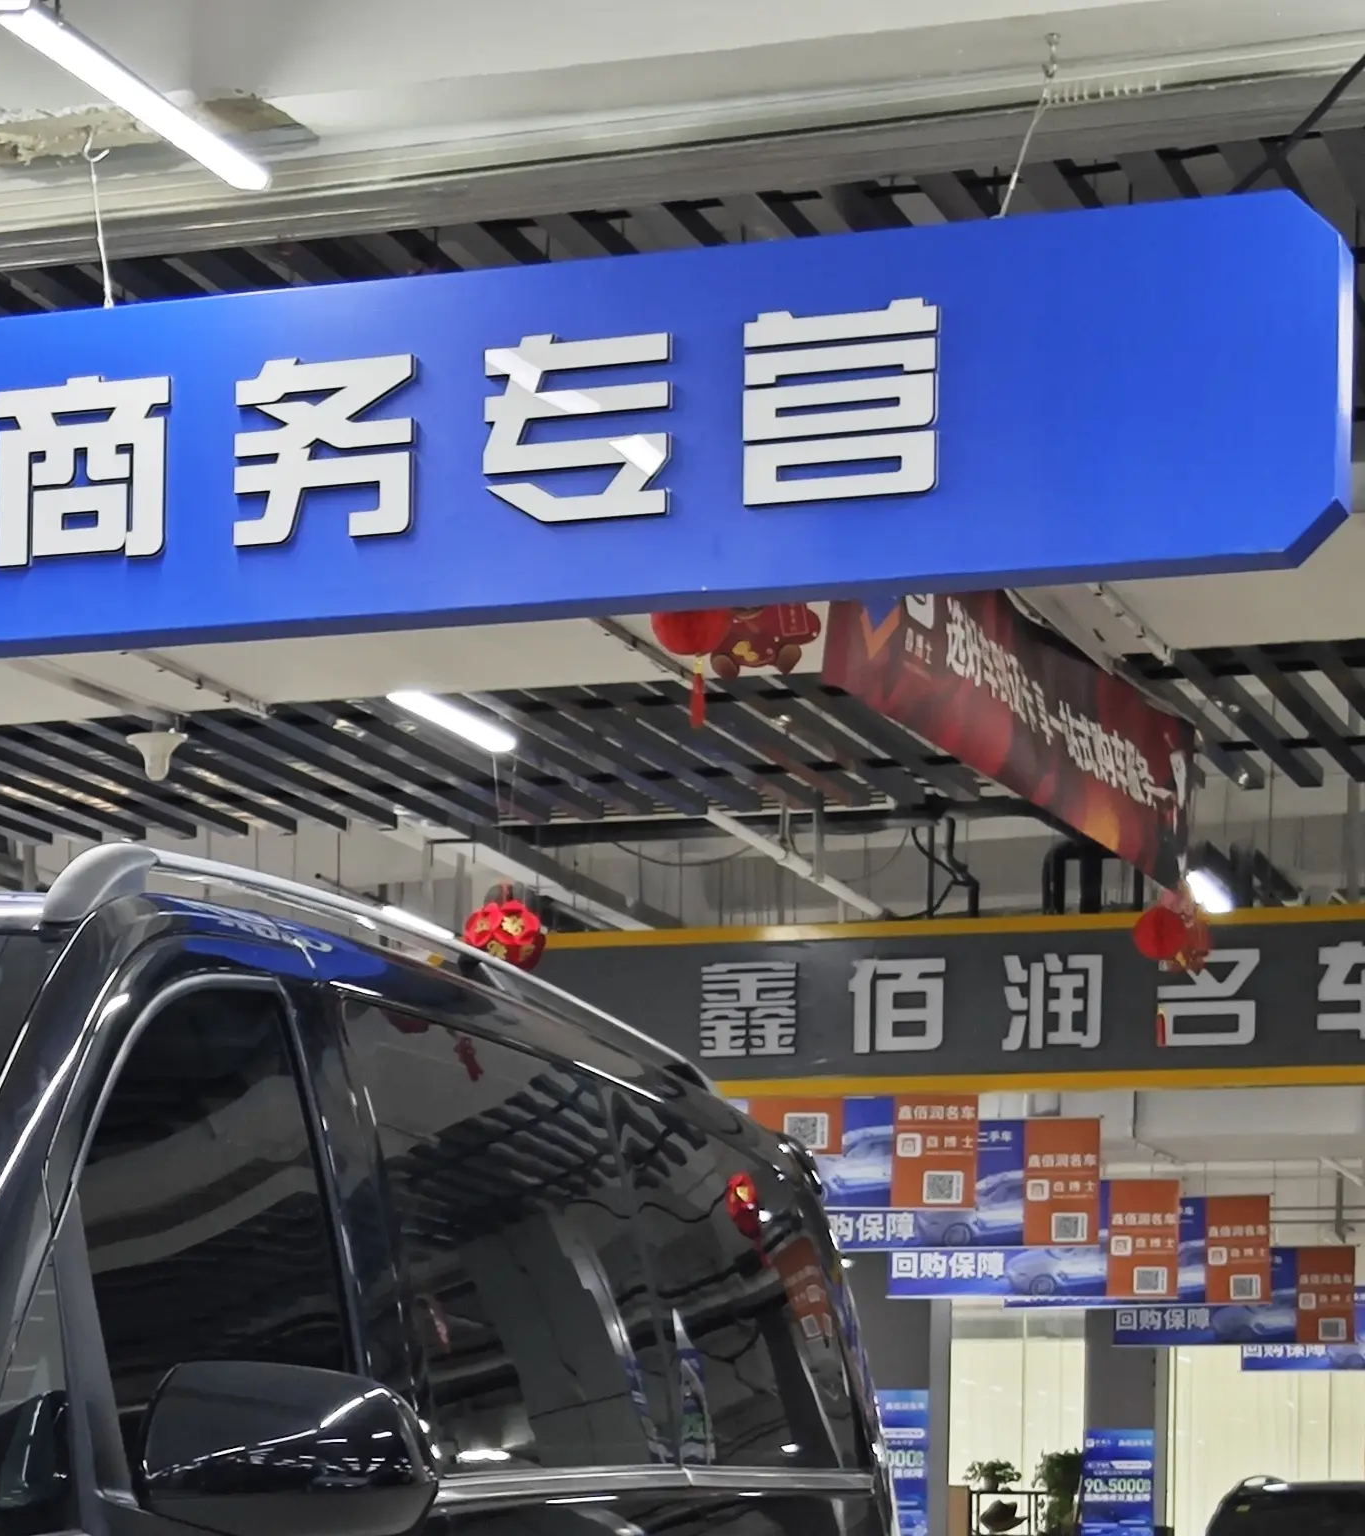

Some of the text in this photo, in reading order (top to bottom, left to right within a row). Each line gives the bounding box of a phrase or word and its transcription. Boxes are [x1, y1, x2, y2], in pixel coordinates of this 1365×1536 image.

[891, 1252, 1005, 1280] 回购保障
[1115, 1308, 1211, 1331] 回购保障
